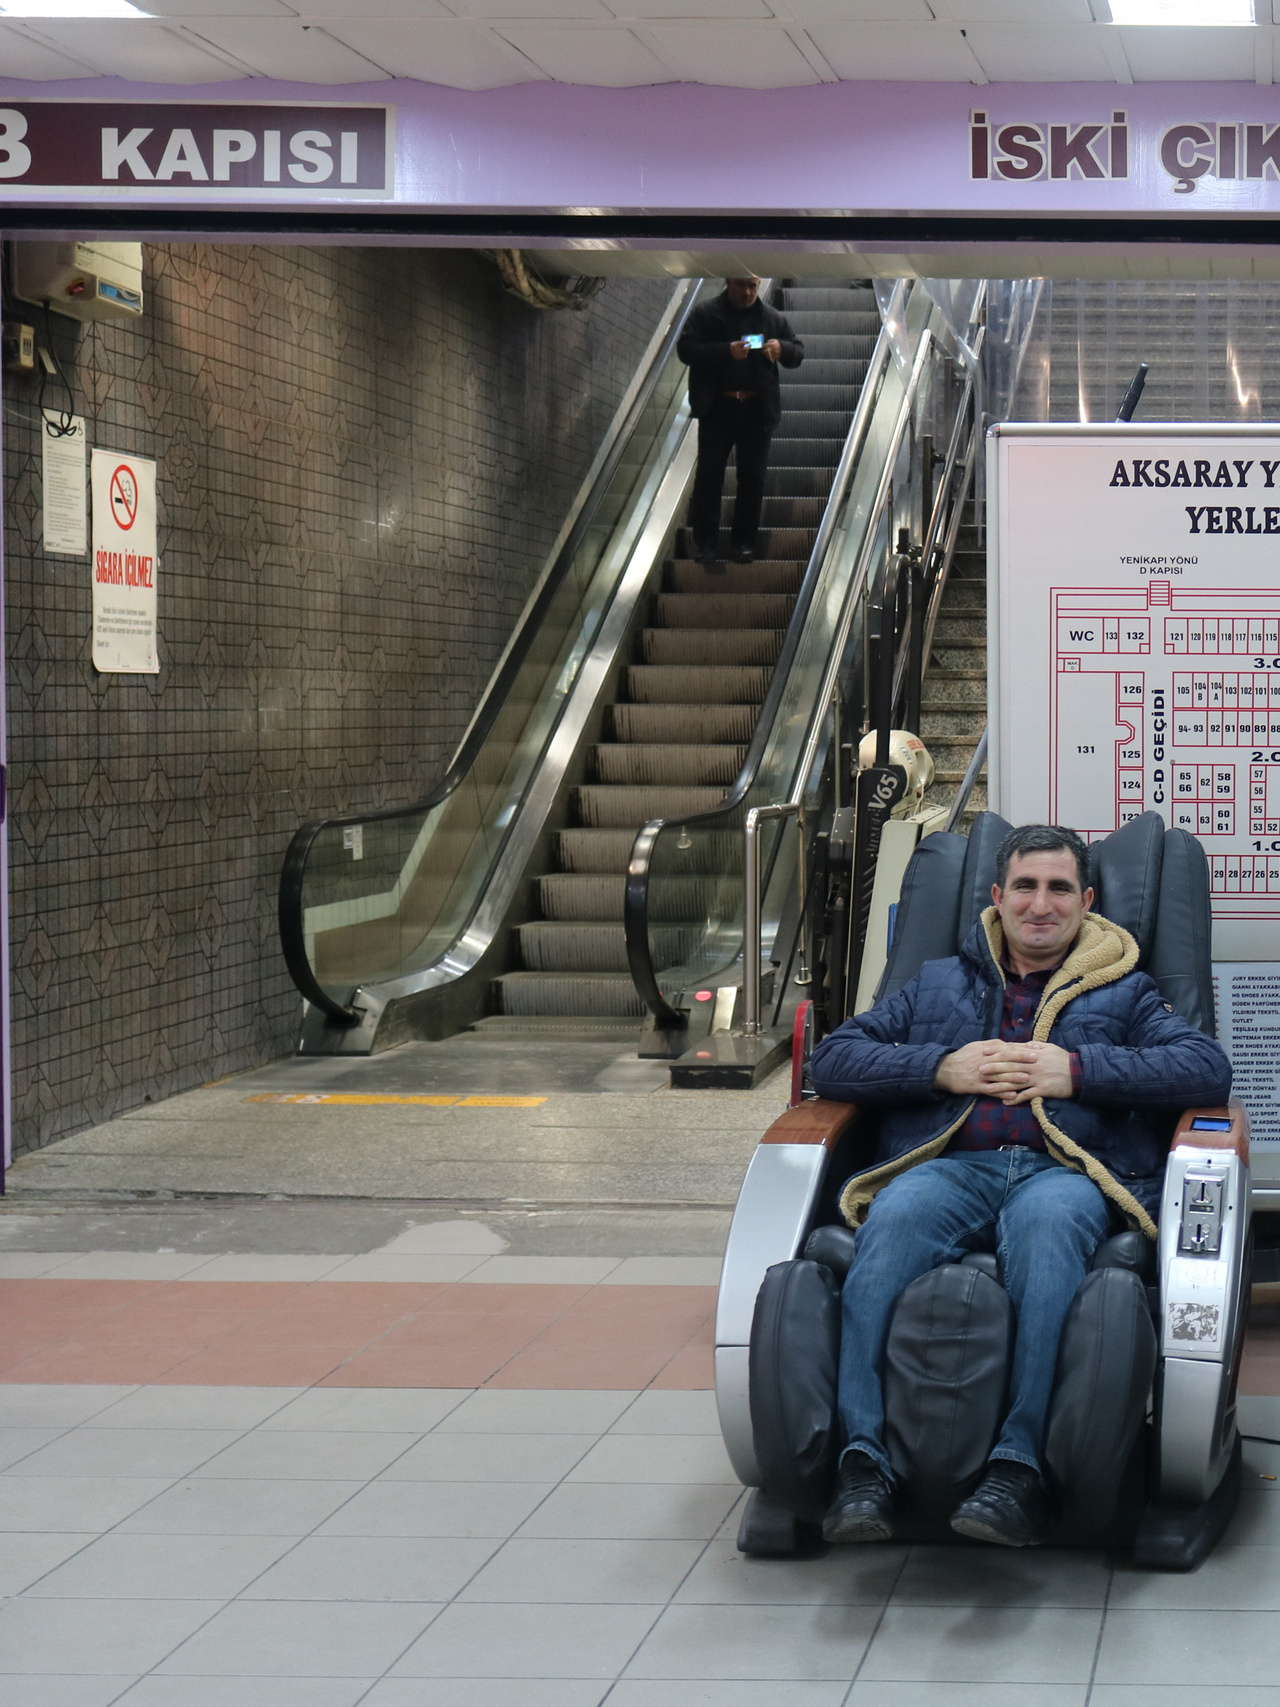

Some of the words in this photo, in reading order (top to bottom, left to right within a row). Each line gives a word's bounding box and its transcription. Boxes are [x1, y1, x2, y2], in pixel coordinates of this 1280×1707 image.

[970, 110, 1130, 181] İSKİ
[101, 127, 358, 184] KAPISI
[1109, 460, 1254, 487] AKSARAY
[96, 545, 123, 586] SİGARA
[125, 548, 153, 592] İÇİLMEZ
[1120, 555, 1167, 565] YENİKAPI
[1170, 556, 1197, 564] YÖNÜ
[1070, 631, 1093, 641] WC
[1221, 633, 1231, 641] 118
[1236, 633, 1246, 641] 117
[1152, 690, 1167, 761] GEÇİDİ
[867, 773, 898, 809] V65
[1154, 769, 1164, 803] C-D
[1200, 816, 1210, 824] 63
[1214, 870, 1223, 878] 29
[1229, 870, 1238, 878] 28
